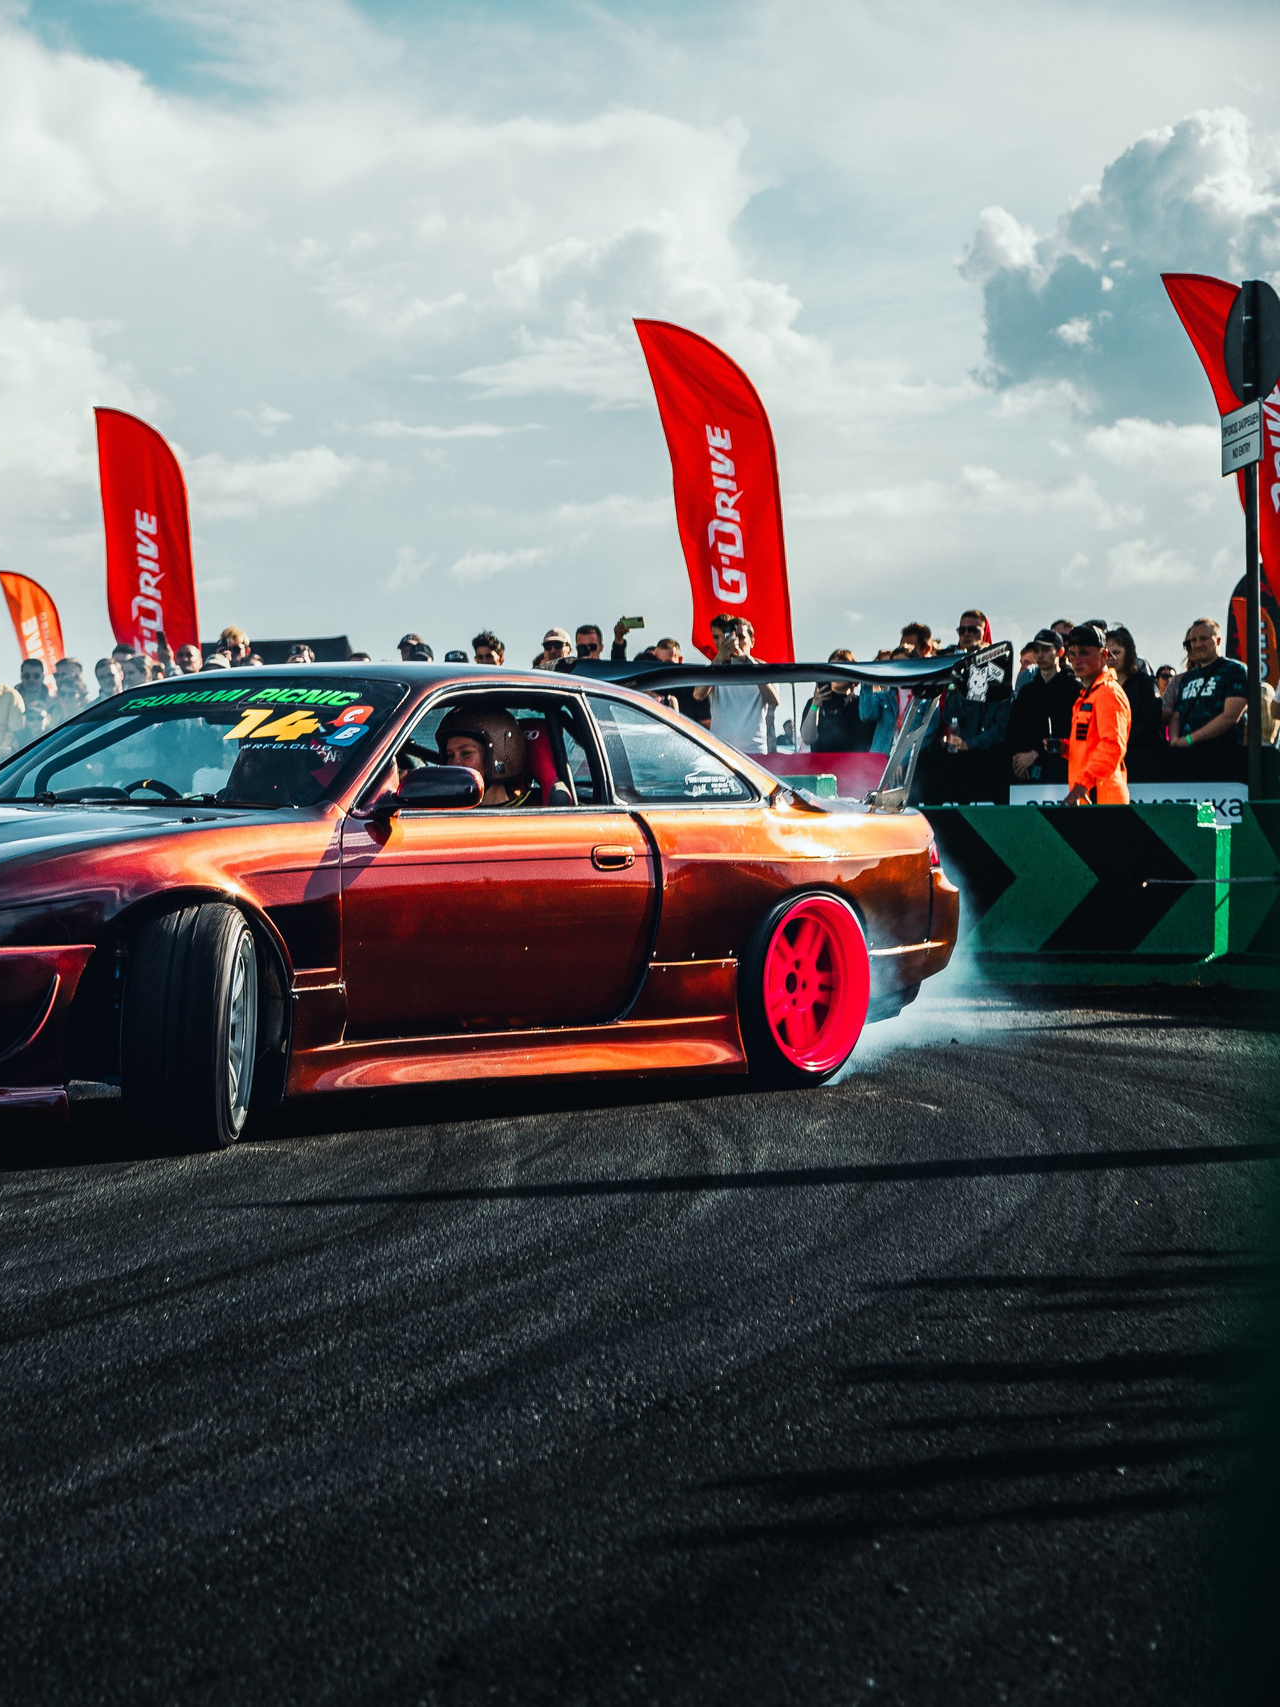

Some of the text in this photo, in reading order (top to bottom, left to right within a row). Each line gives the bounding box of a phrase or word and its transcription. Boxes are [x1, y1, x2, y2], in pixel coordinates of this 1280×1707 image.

[117, 688, 361, 711] TSUNAMI PICNIC
[222, 708, 322, 741] 14
